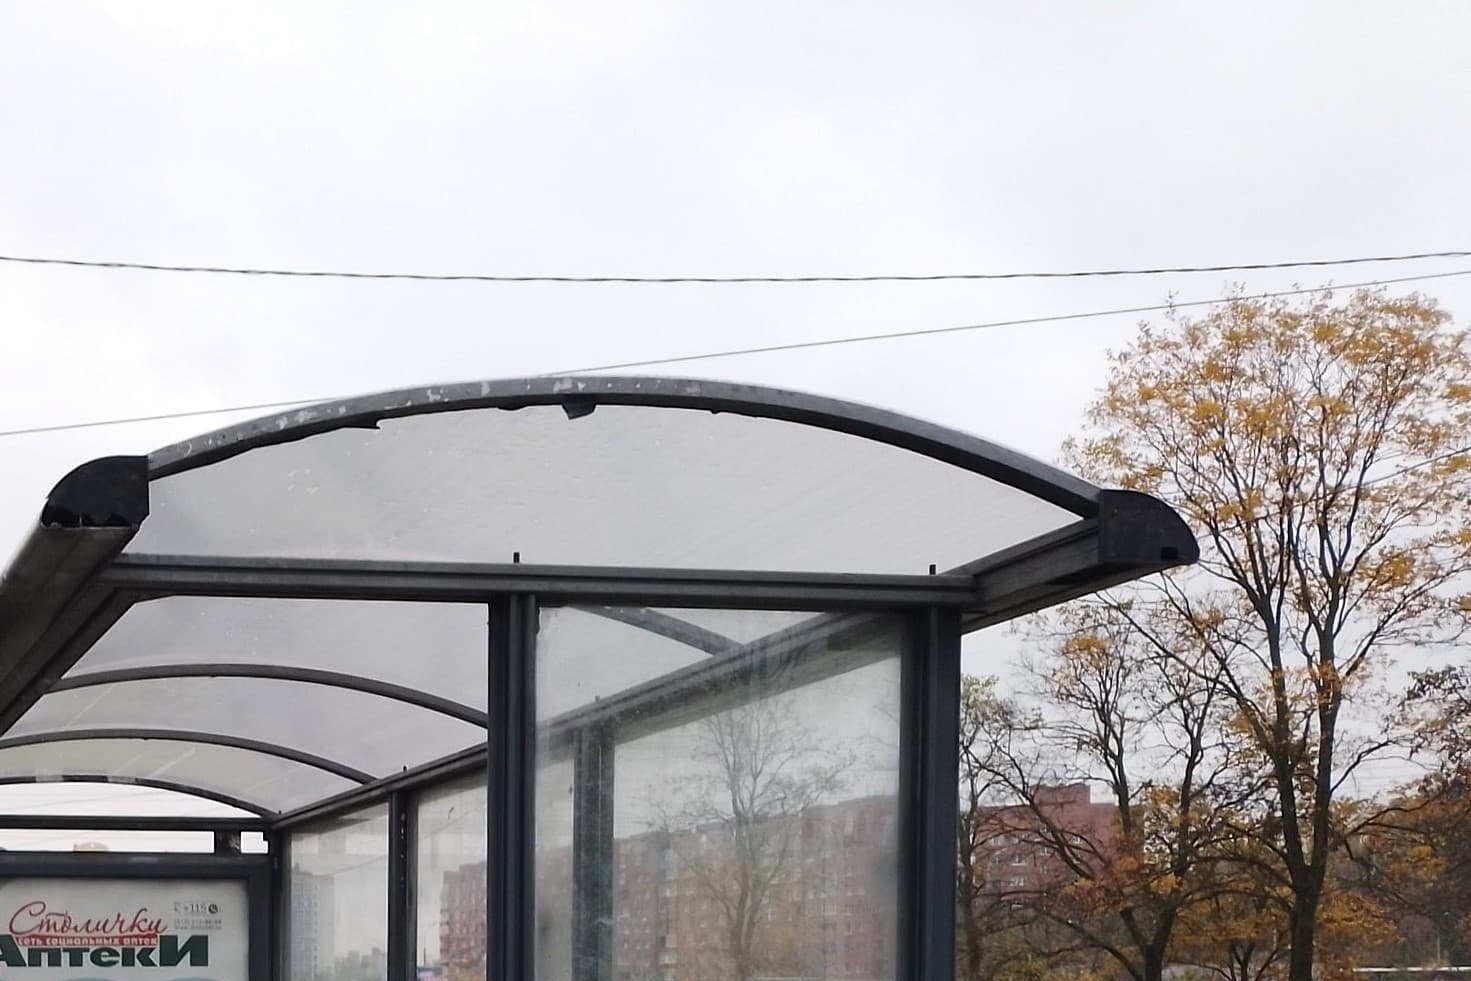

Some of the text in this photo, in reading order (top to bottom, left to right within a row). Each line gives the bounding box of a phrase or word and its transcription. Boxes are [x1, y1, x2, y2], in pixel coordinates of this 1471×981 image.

[9, 901, 168, 935] Столички
[18, 936, 157, 946] сеть социальных аптек
